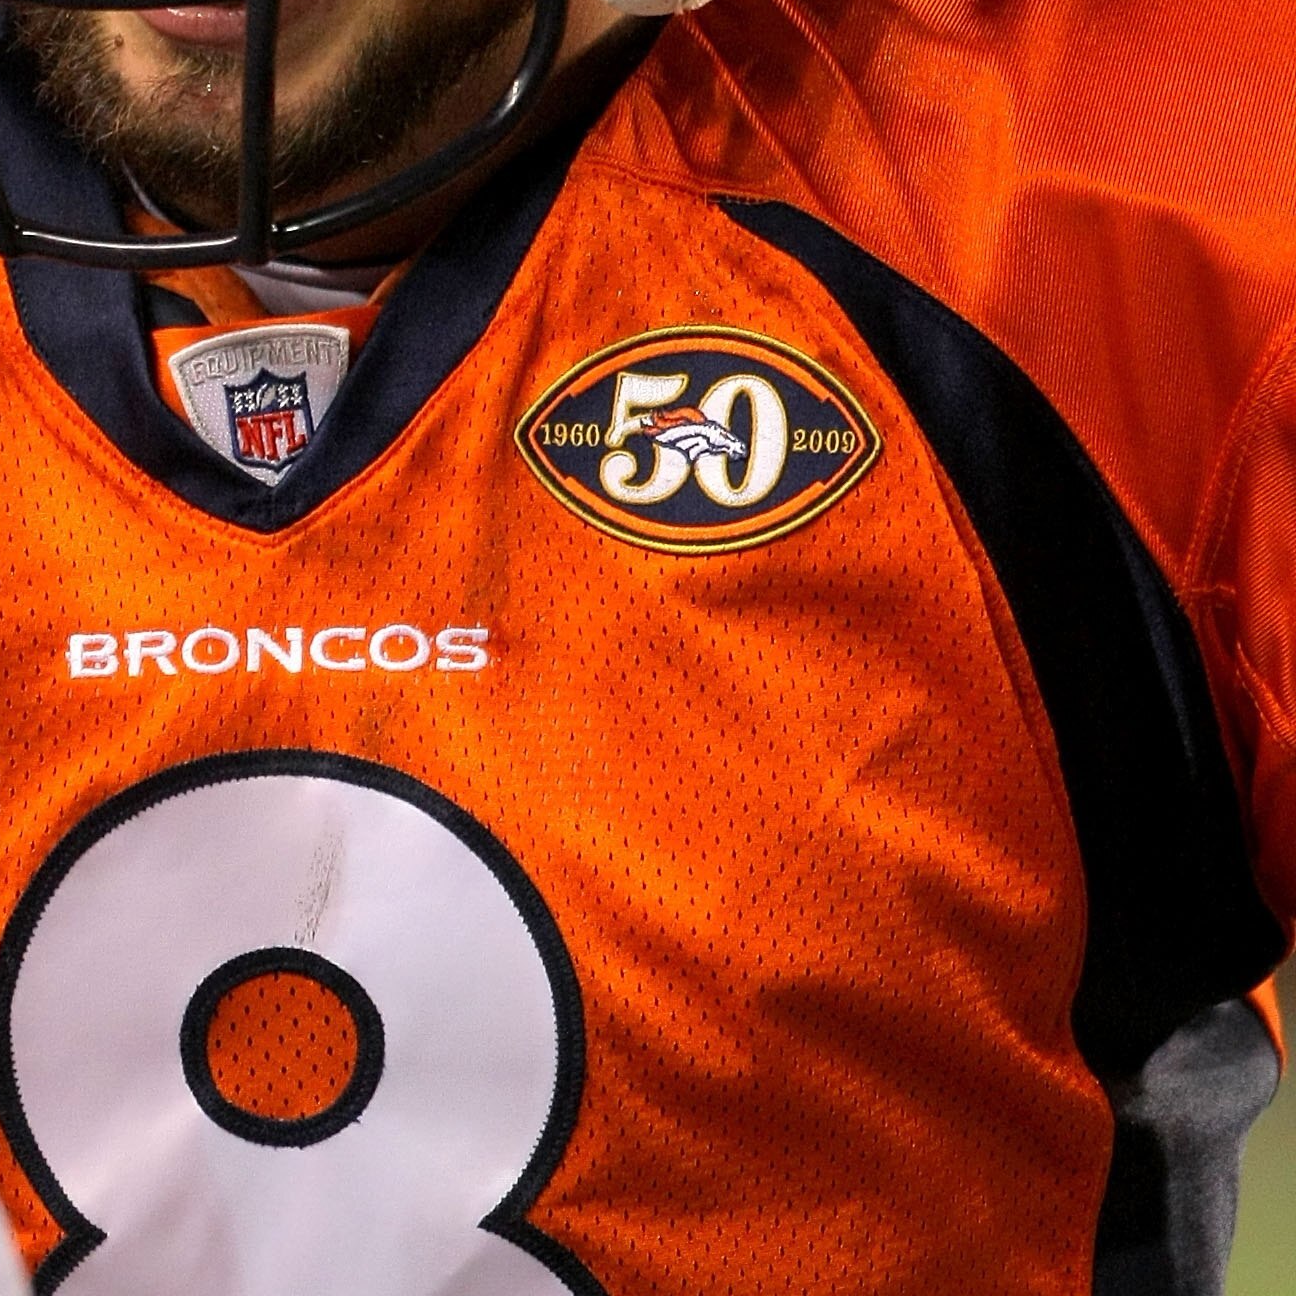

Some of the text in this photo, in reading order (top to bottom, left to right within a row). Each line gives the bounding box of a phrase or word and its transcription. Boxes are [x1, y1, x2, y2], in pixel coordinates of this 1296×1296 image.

[190, 336, 342, 386] EQUIPMENT
[235, 411, 309, 462] NFL
[540, 371, 857, 508] 1960 50 2009
[65, 624, 490, 679] BRONCOS
